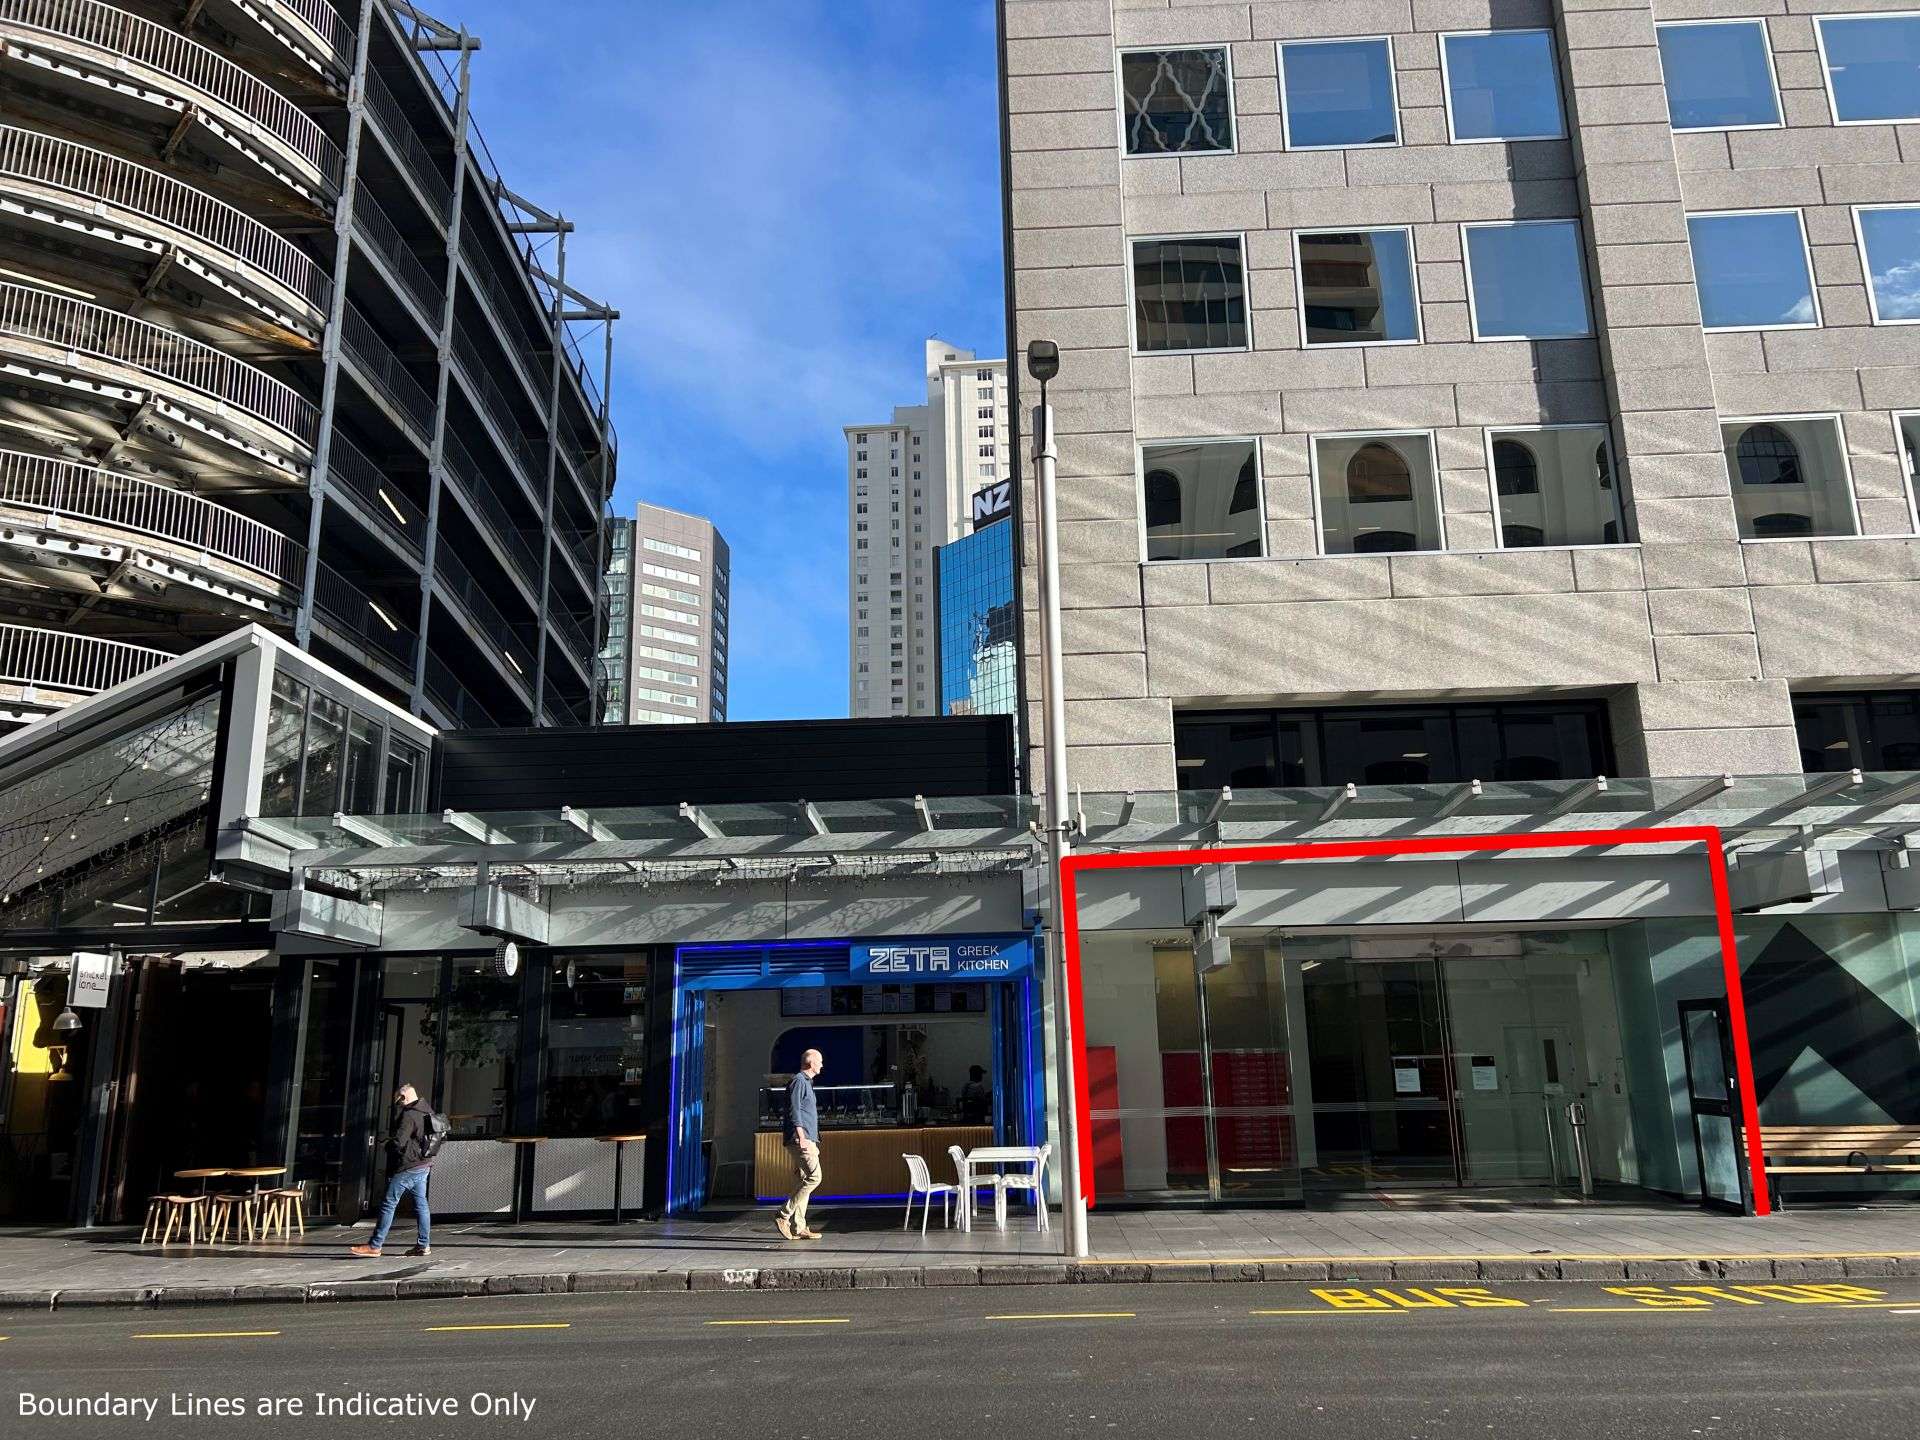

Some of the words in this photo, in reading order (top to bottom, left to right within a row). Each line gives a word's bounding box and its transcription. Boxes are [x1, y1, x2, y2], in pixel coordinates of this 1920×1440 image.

[869, 946, 950, 973] ZETA
[957, 945, 999, 956] GREEK
[957, 959, 1009, 971] KITCHEN
[1308, 1288, 1530, 1308] BUS
[1601, 1284, 1889, 1305] STOP
